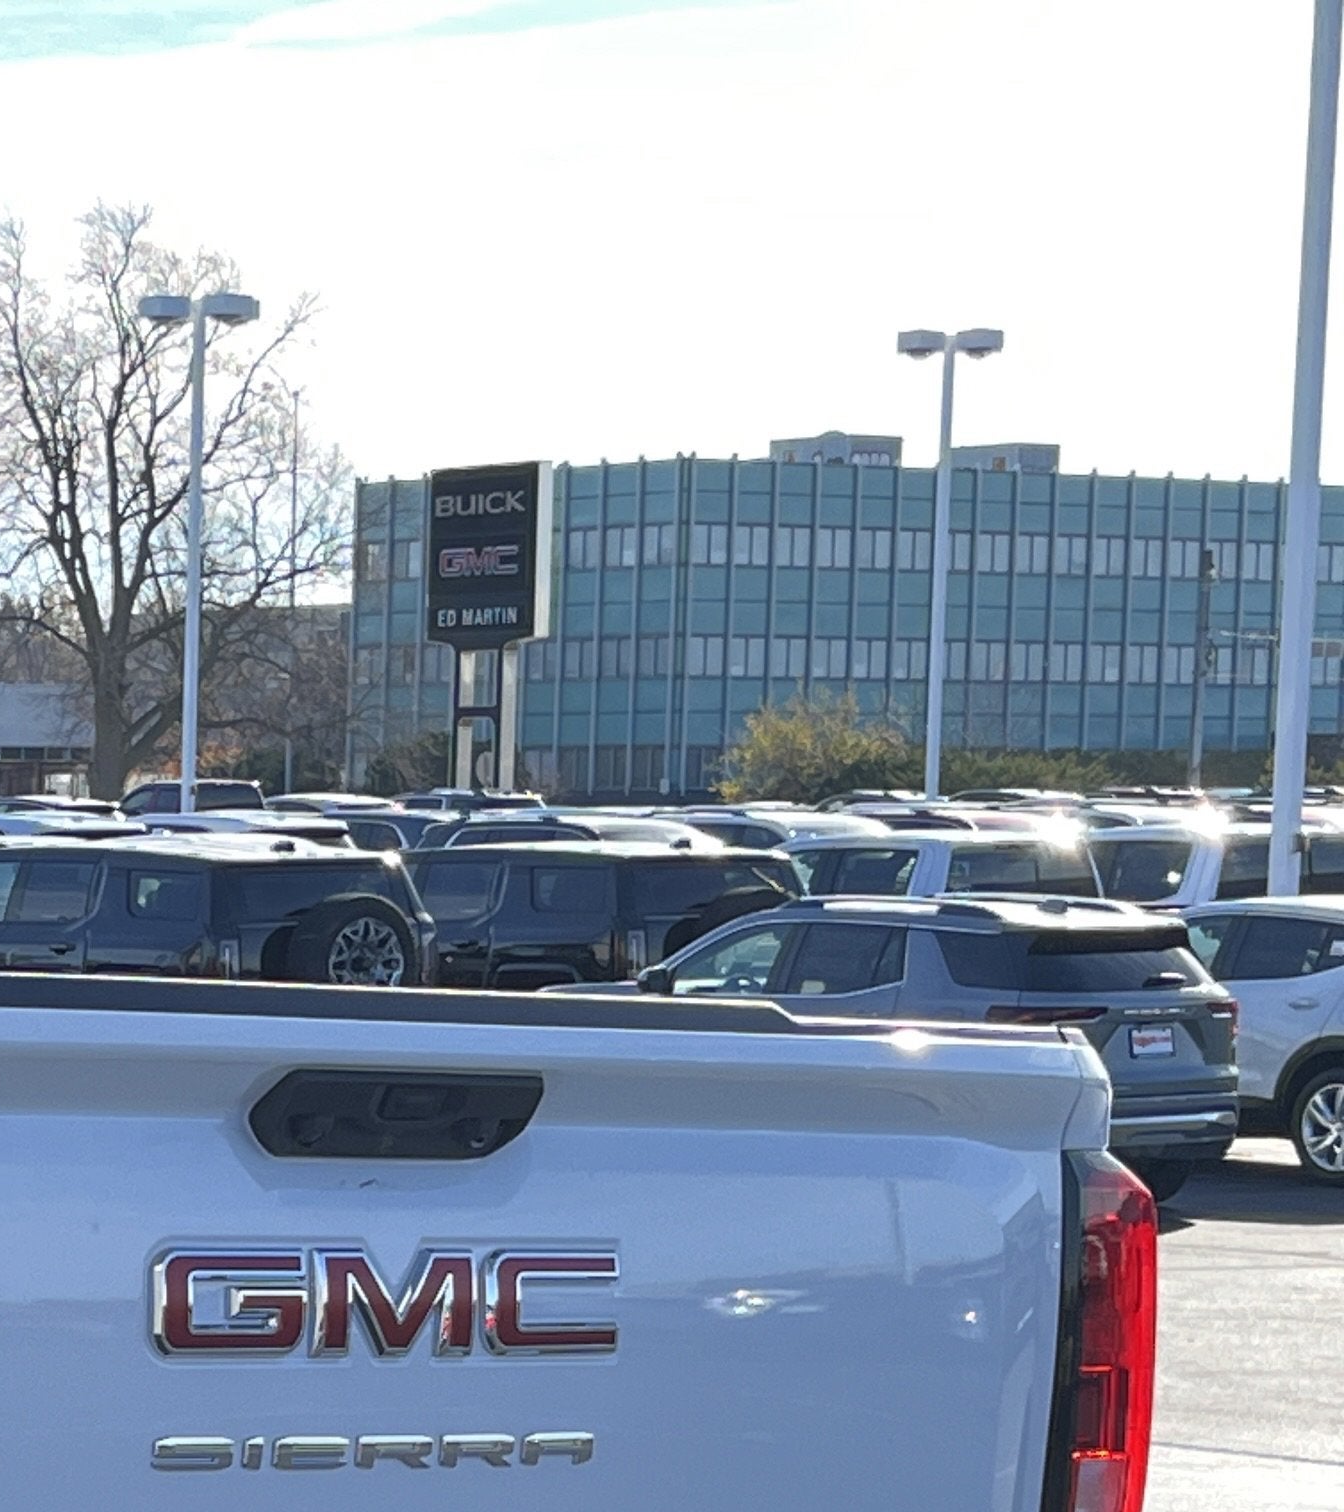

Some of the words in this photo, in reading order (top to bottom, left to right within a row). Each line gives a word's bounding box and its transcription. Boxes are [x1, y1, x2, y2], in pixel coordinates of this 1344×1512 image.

[434, 490, 526, 518] BUICK
[438, 545, 520, 578] GMC
[437, 609, 457, 628] ED
[462, 607, 518, 626] MARTIN
[152, 1246, 620, 1358] GMC
[150, 1431, 595, 1471] SIERRA
